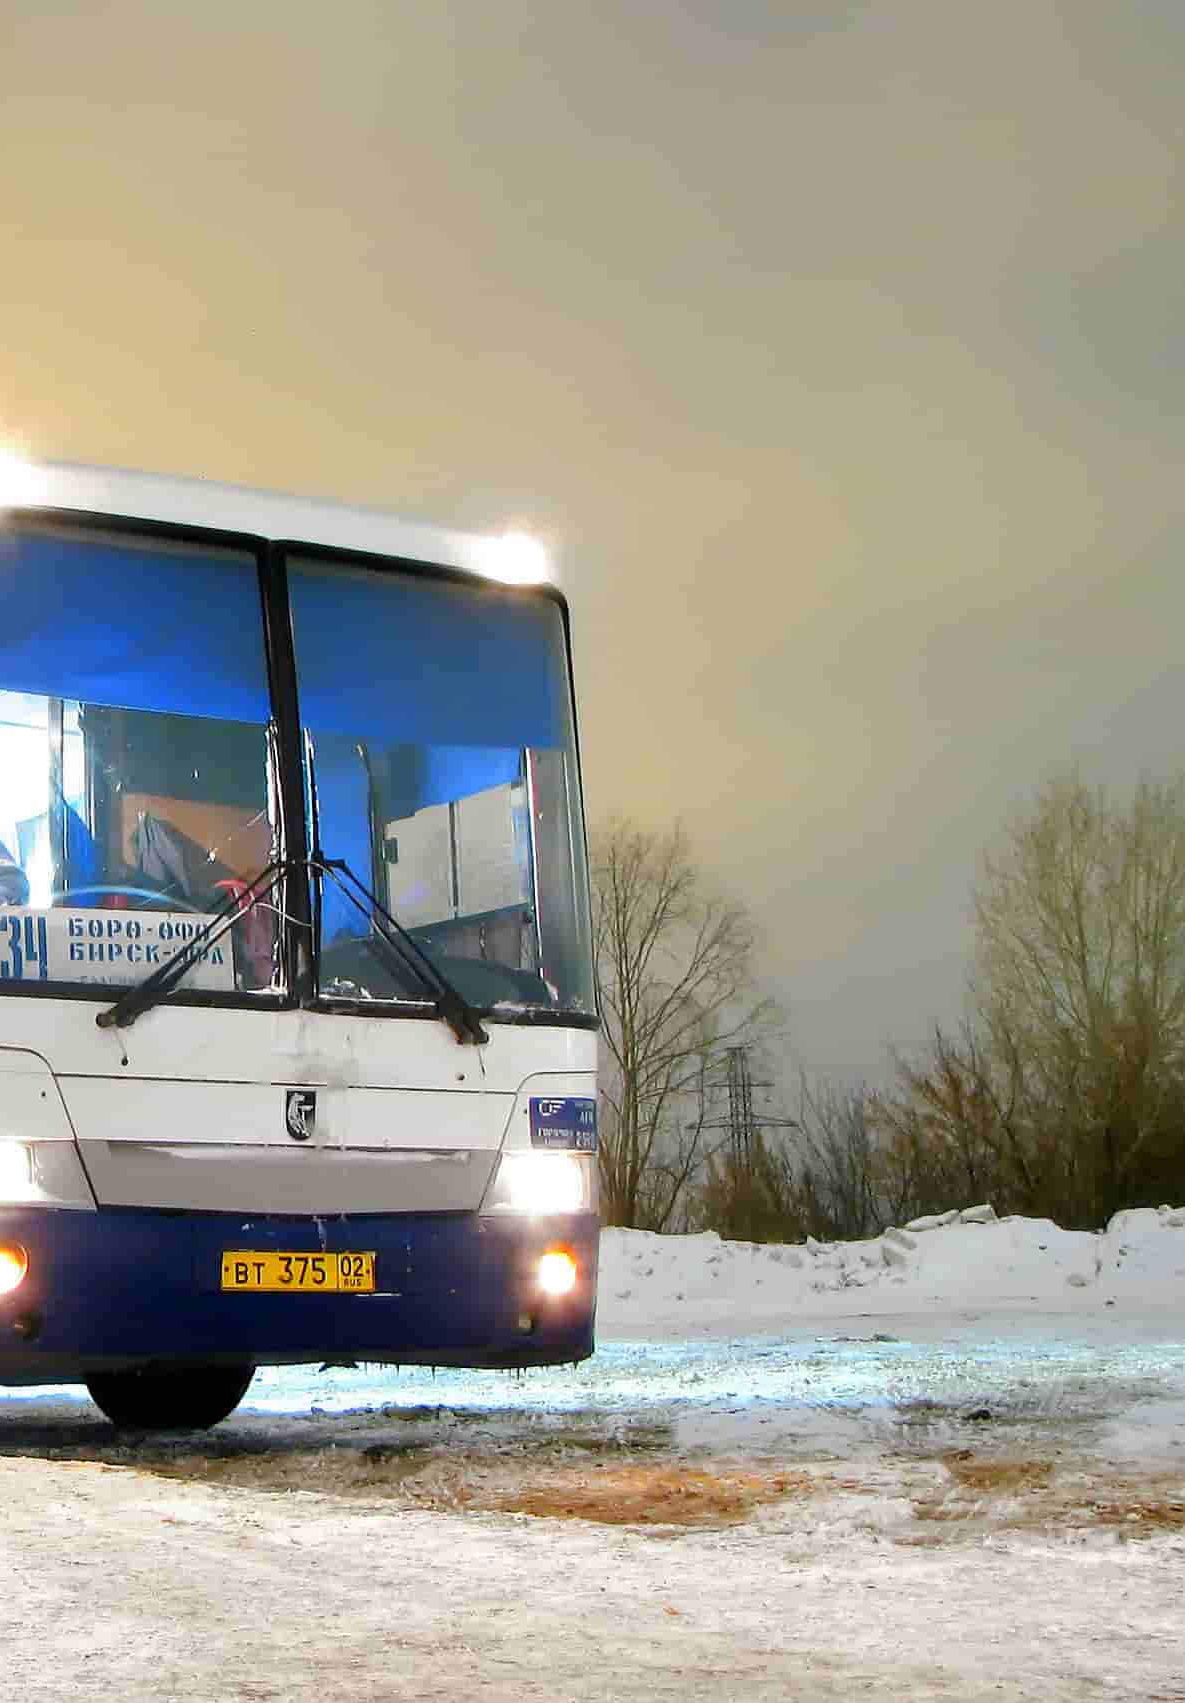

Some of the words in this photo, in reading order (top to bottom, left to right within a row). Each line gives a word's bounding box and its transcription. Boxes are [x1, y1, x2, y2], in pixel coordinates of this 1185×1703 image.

[69, 942, 224, 965] БИРСК-ФА
[278, 1256, 327, 1285] 375
[340, 1255, 364, 1277] 02
